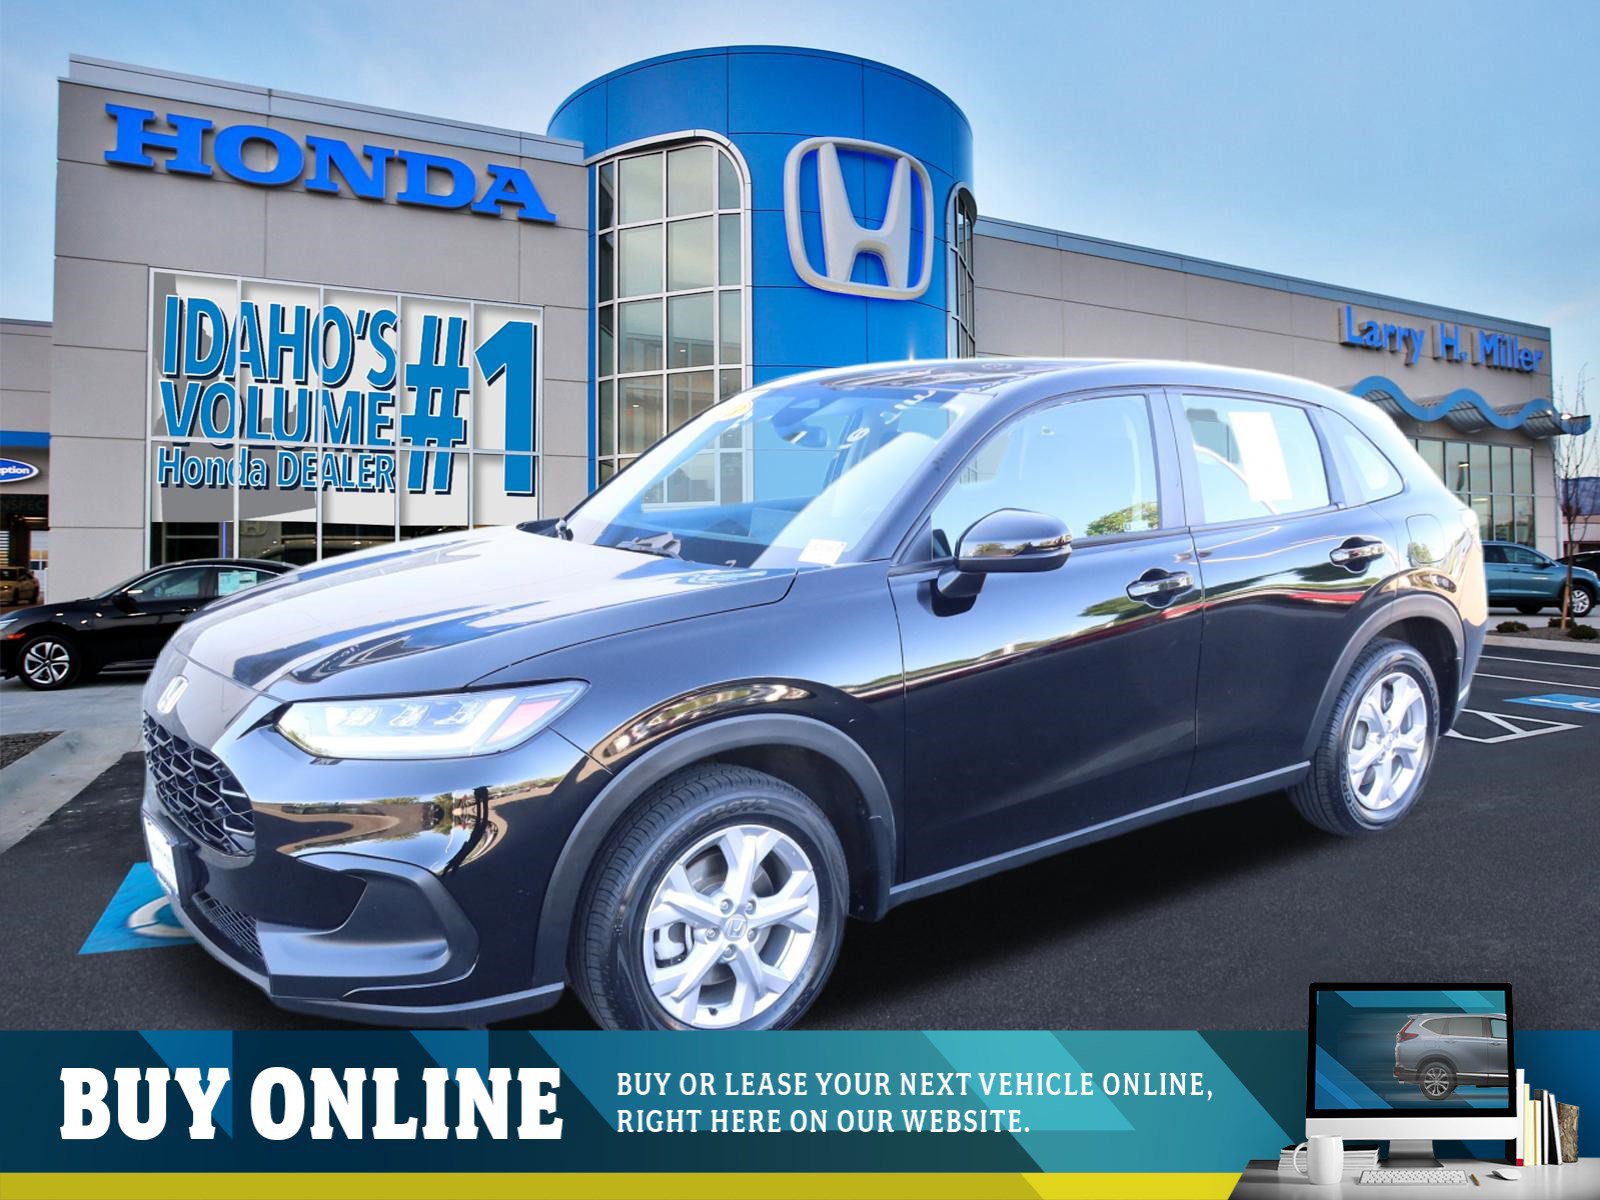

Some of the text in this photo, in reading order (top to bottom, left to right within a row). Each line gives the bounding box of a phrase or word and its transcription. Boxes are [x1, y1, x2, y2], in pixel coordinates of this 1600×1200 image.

[104, 103, 557, 224] HONDA
[1340, 304, 1546, 373] Larry H. Miller
[159, 380, 396, 452] VOLUME
[163, 294, 538, 497] IDAHO'S #1
[0, 465, 30, 476] ption
[156, 446, 396, 493] Honda DEALER
